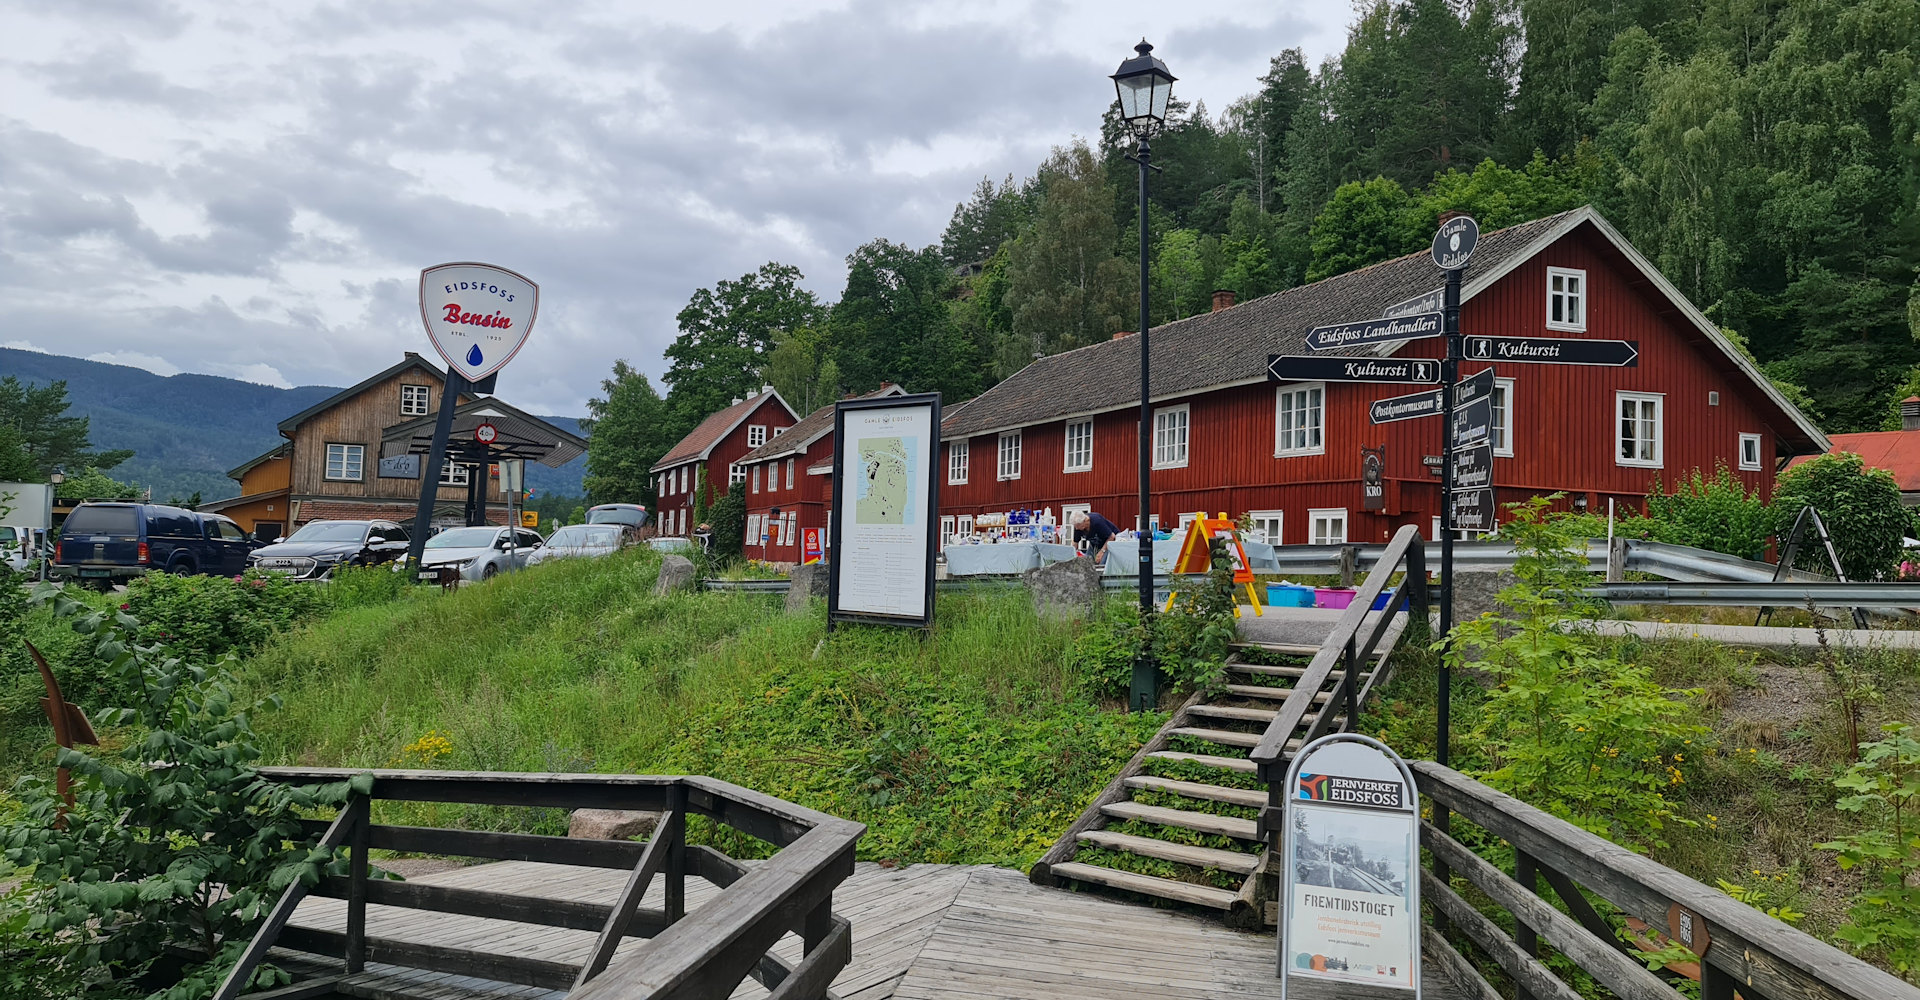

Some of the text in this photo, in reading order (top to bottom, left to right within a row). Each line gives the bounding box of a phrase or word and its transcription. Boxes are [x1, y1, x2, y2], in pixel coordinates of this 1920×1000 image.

[1442, 219, 1467, 238] Gamle
[1442, 251, 1468, 267] Eidsfos
[445, 281, 515, 303] EIDSFOSS
[442, 303, 513, 329] Bensin
[1318, 317, 1438, 345] Eidsfoss Landhandleri
[1497, 341, 1561, 358] Kultursti
[1344, 361, 1408, 378] Kultursti
[1374, 399, 1434, 418] Postkontormuseum
[1366, 486, 1382, 497] KRO
[1331, 778, 1399, 793] JERNVERKET
[1331, 788, 1399, 806] EIDSFOSS
[1304, 894, 1395, 917] FREMTIDSTOGET
